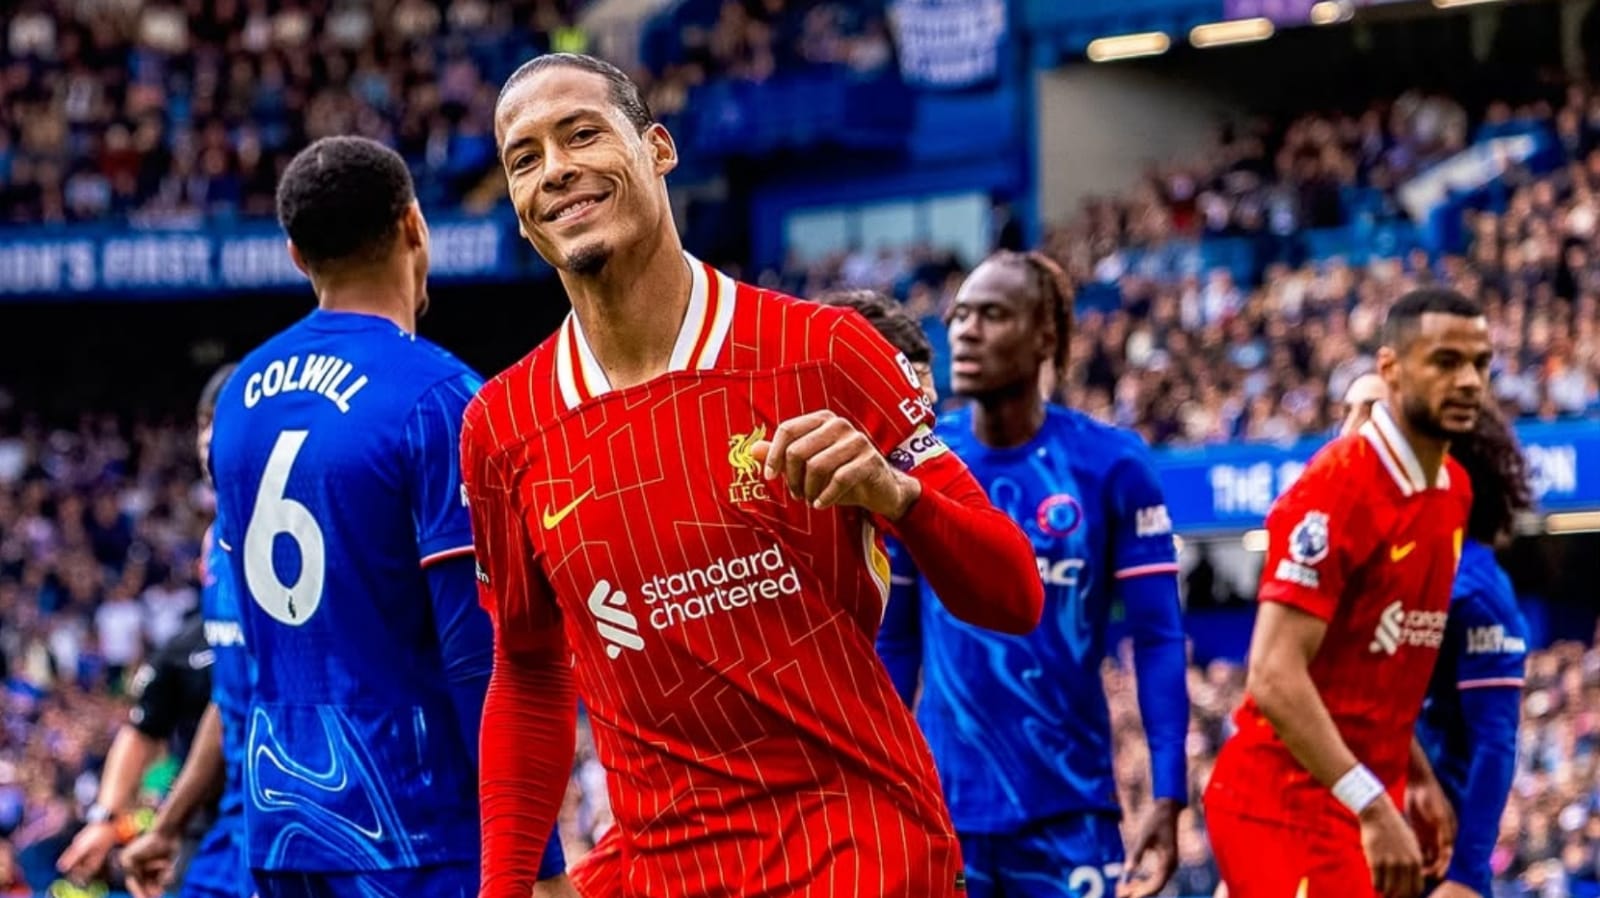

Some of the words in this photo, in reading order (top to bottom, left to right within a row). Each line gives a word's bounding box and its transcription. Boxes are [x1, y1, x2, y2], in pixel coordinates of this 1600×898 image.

[244, 354, 368, 413] COLWILL
[243, 430, 325, 626] 6
[641, 544, 784, 604] standard
[650, 567, 801, 629] chartered
